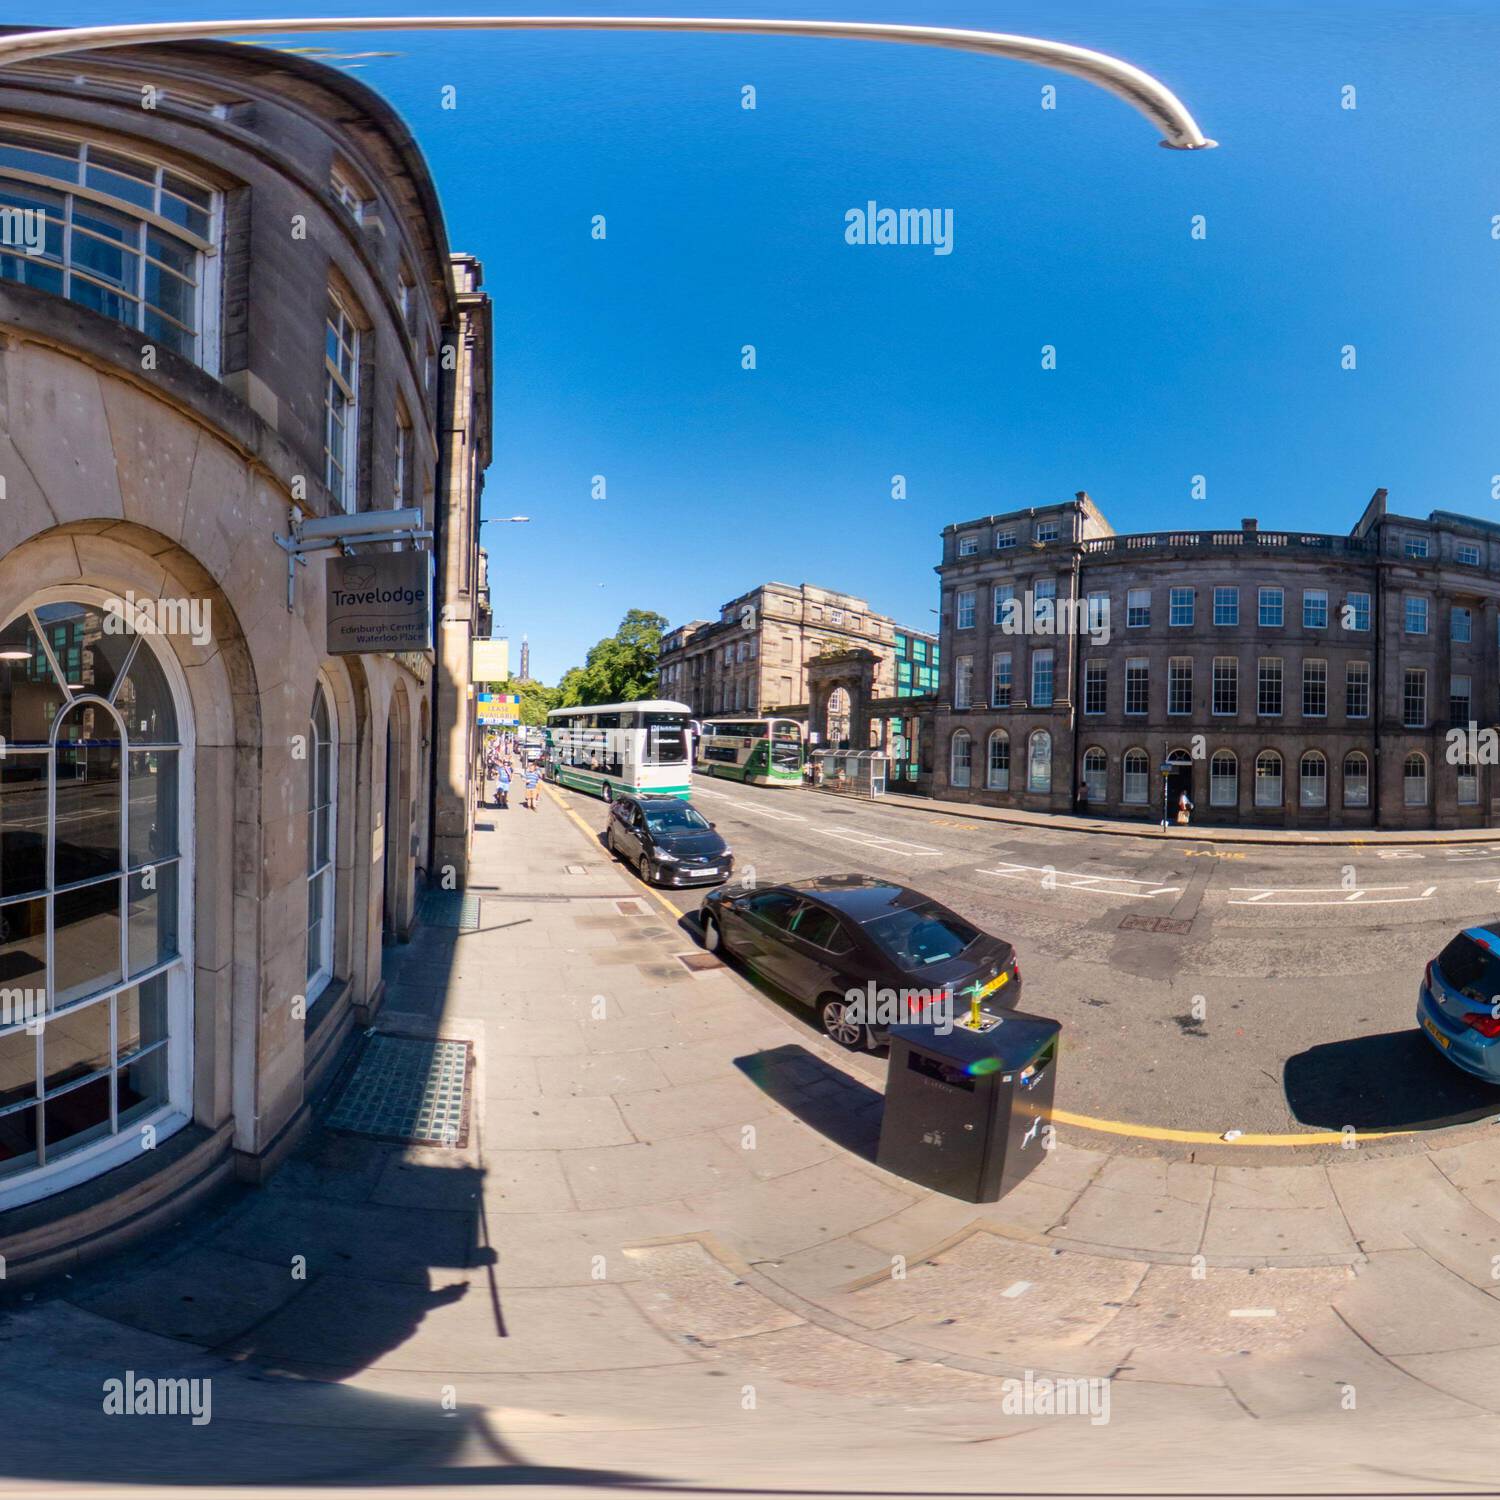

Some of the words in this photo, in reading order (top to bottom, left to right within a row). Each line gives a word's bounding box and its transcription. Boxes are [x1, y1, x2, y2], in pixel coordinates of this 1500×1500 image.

[332, 587, 425, 606] Travelodge
[341, 624, 388, 635] Edinburgh
[390, 623, 424, 631] Central
[356, 634, 398, 643] Waterloo
[399, 633, 424, 641] Place
